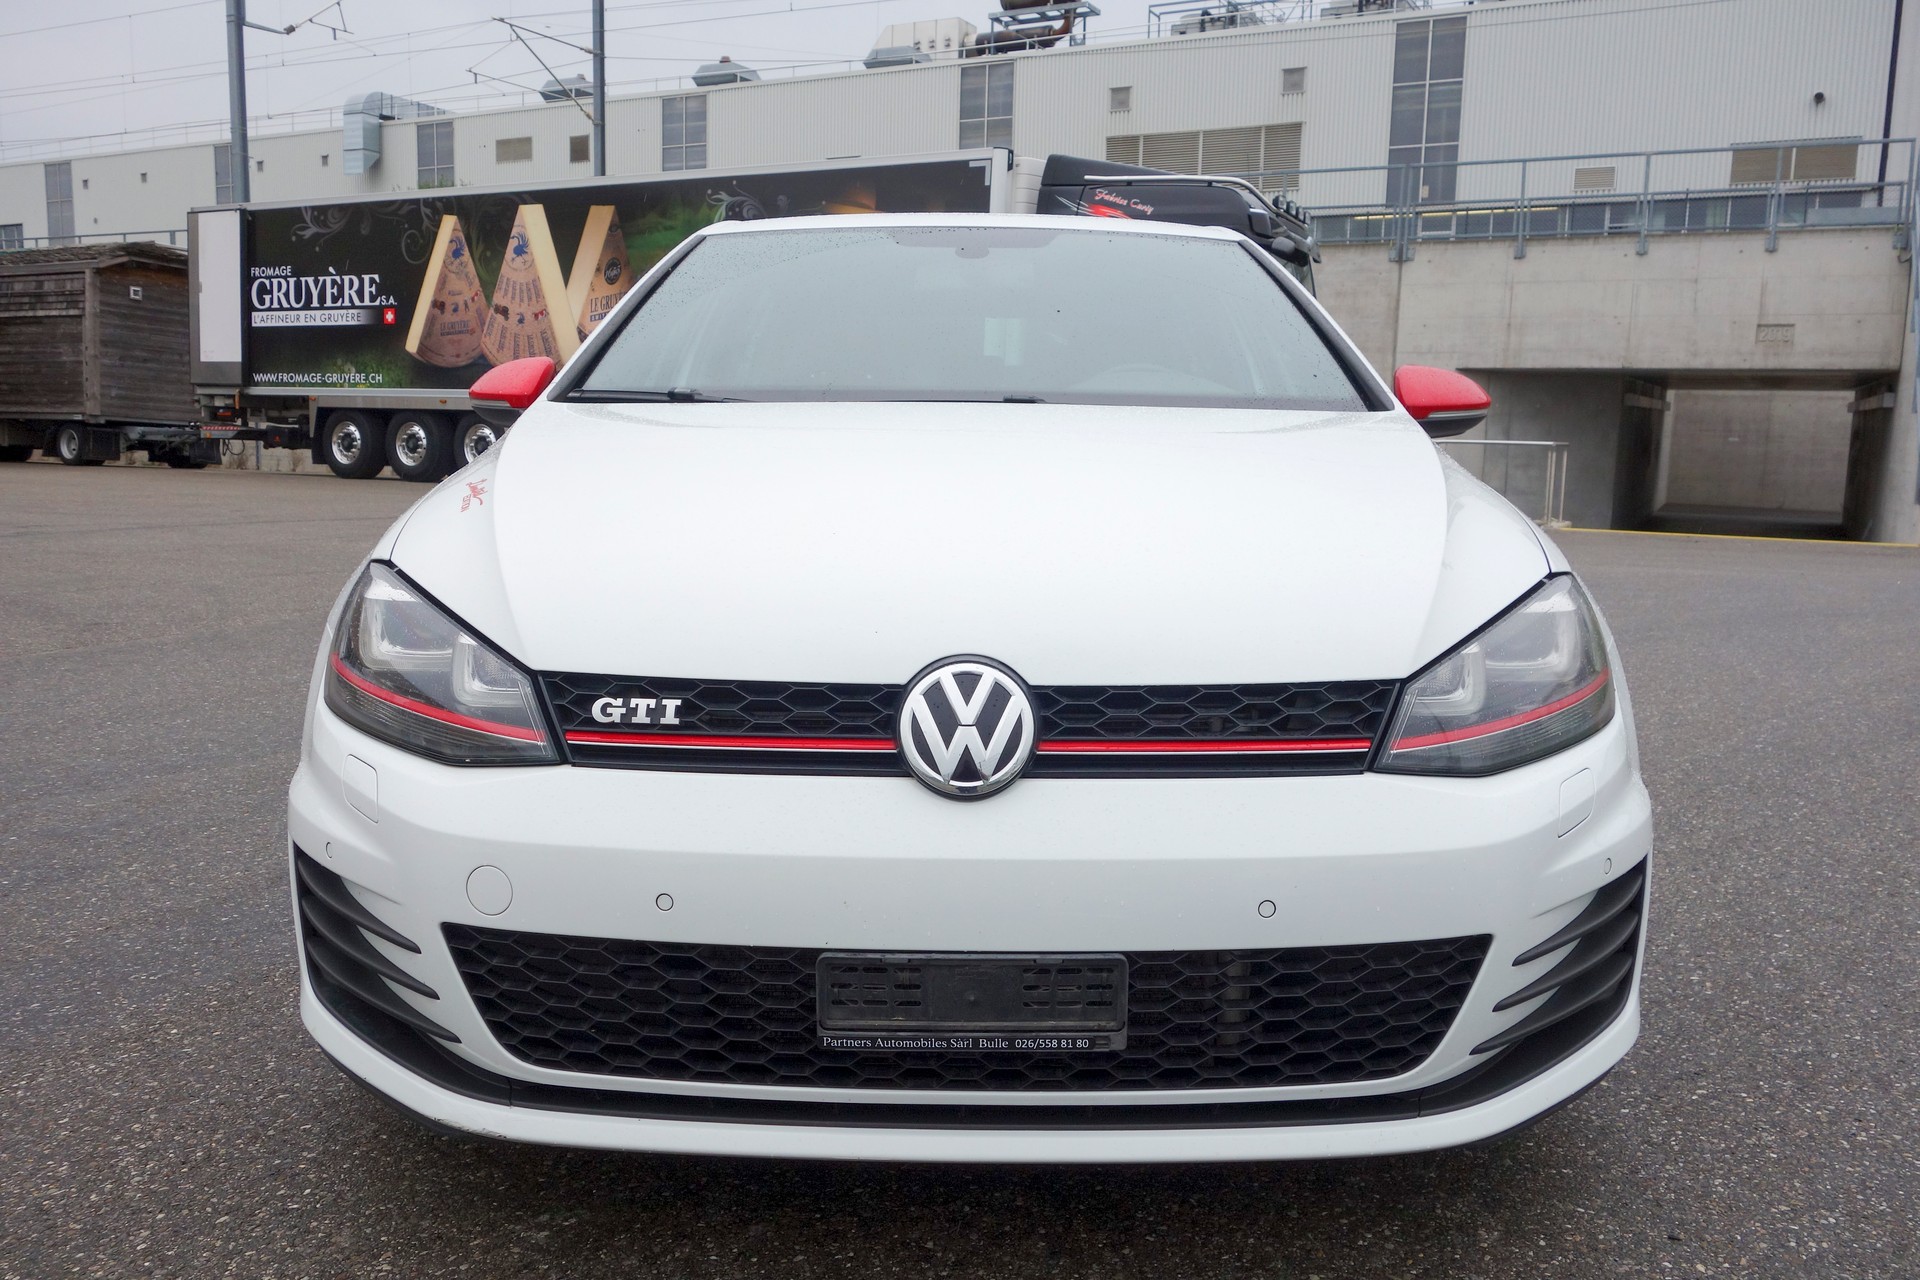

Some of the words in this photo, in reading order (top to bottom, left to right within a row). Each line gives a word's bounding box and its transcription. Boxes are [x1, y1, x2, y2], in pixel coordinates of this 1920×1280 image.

[251, 265, 292, 277] FROMAGE
[251, 266, 381, 309] GRUYÈRE
[381, 295, 397, 305] S.A.
[253, 313, 301, 324] L'AFFINEUR
[304, 314, 317, 323] EN
[319, 310, 362, 323] GRUYÈRE
[253, 373, 383, 383] WWW.FROMAGE-GRUYERE.CH
[591, 697, 682, 725] GTI
[823, 1037, 872, 1048] Partners
[875, 1038, 948, 1049] Automobiles
[979, 1038, 1009, 1049] Bulle
[1015, 1038, 1058, 1050] 026/558
[1060, 1038, 1073, 1049] 81
[1076, 1038, 1090, 1049] 80
